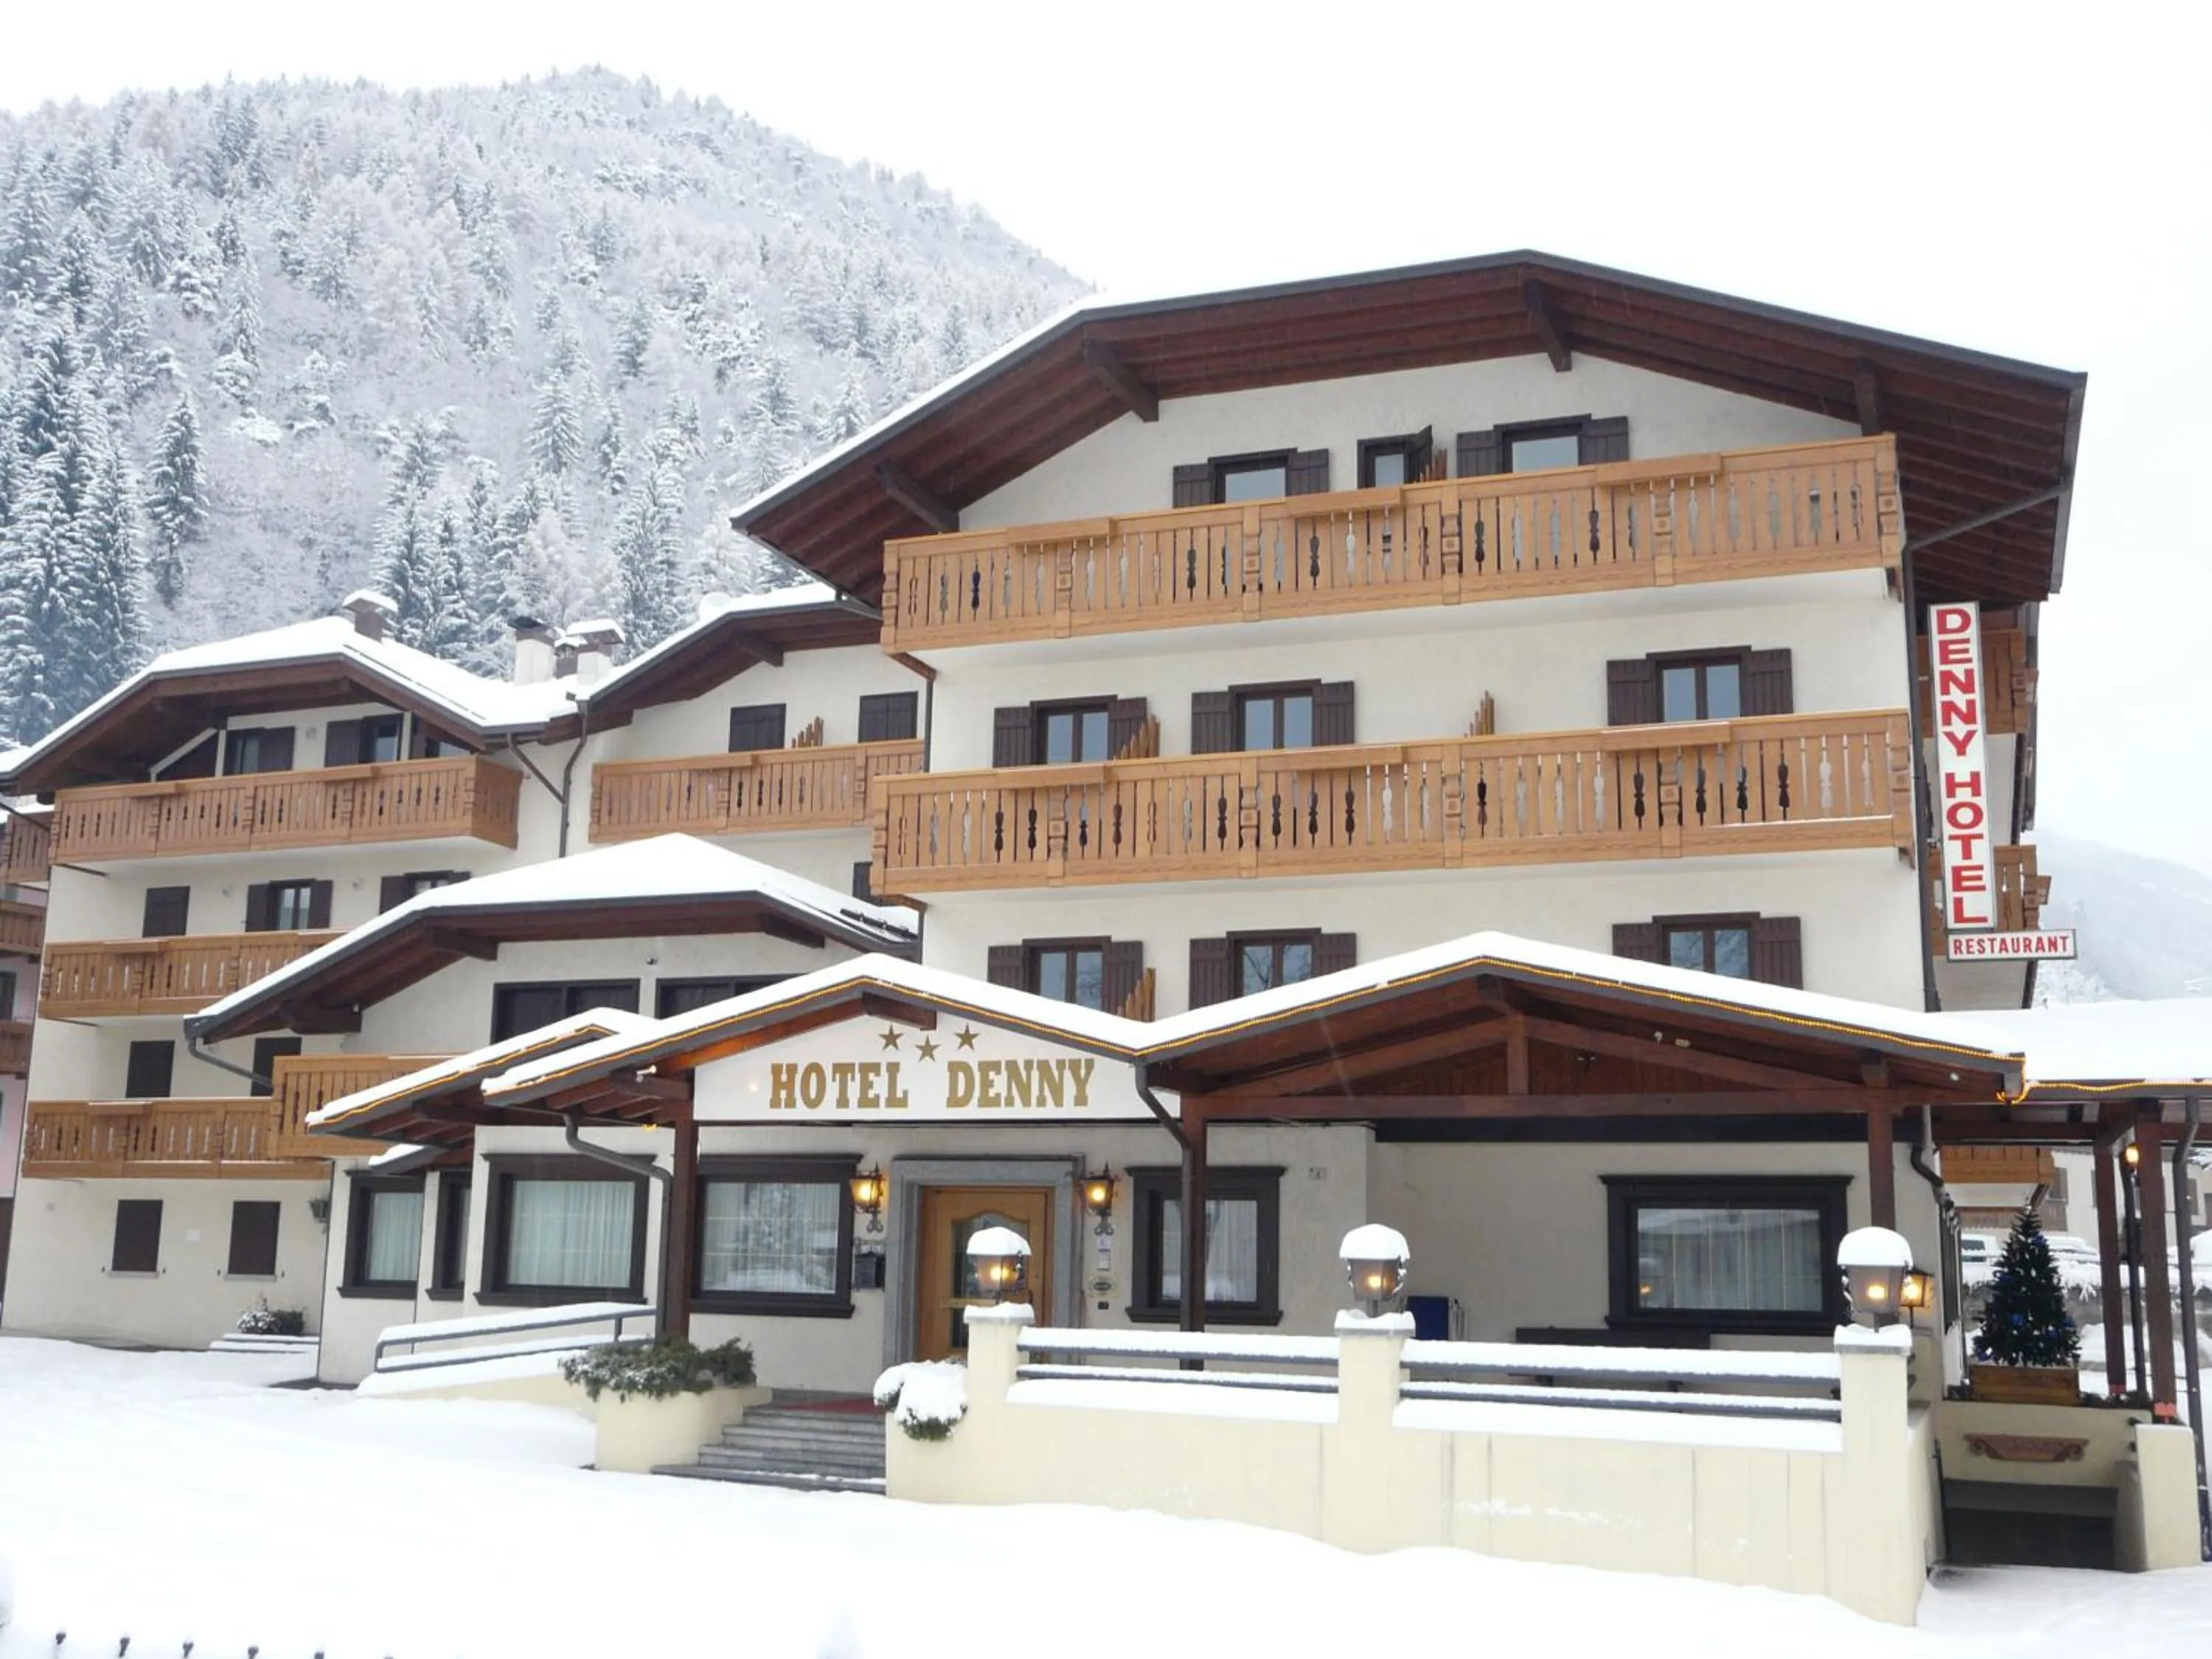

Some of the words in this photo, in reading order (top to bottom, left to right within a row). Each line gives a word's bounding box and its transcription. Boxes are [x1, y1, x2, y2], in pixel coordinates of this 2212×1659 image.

[1935, 608, 1979, 757] DENNY
[1944, 771, 1989, 925] HOTEL
[1953, 936, 2069, 956] RESTAURANT
[769, 1061, 909, 1109] HOTEL
[946, 1058, 1096, 1109] DENNY
